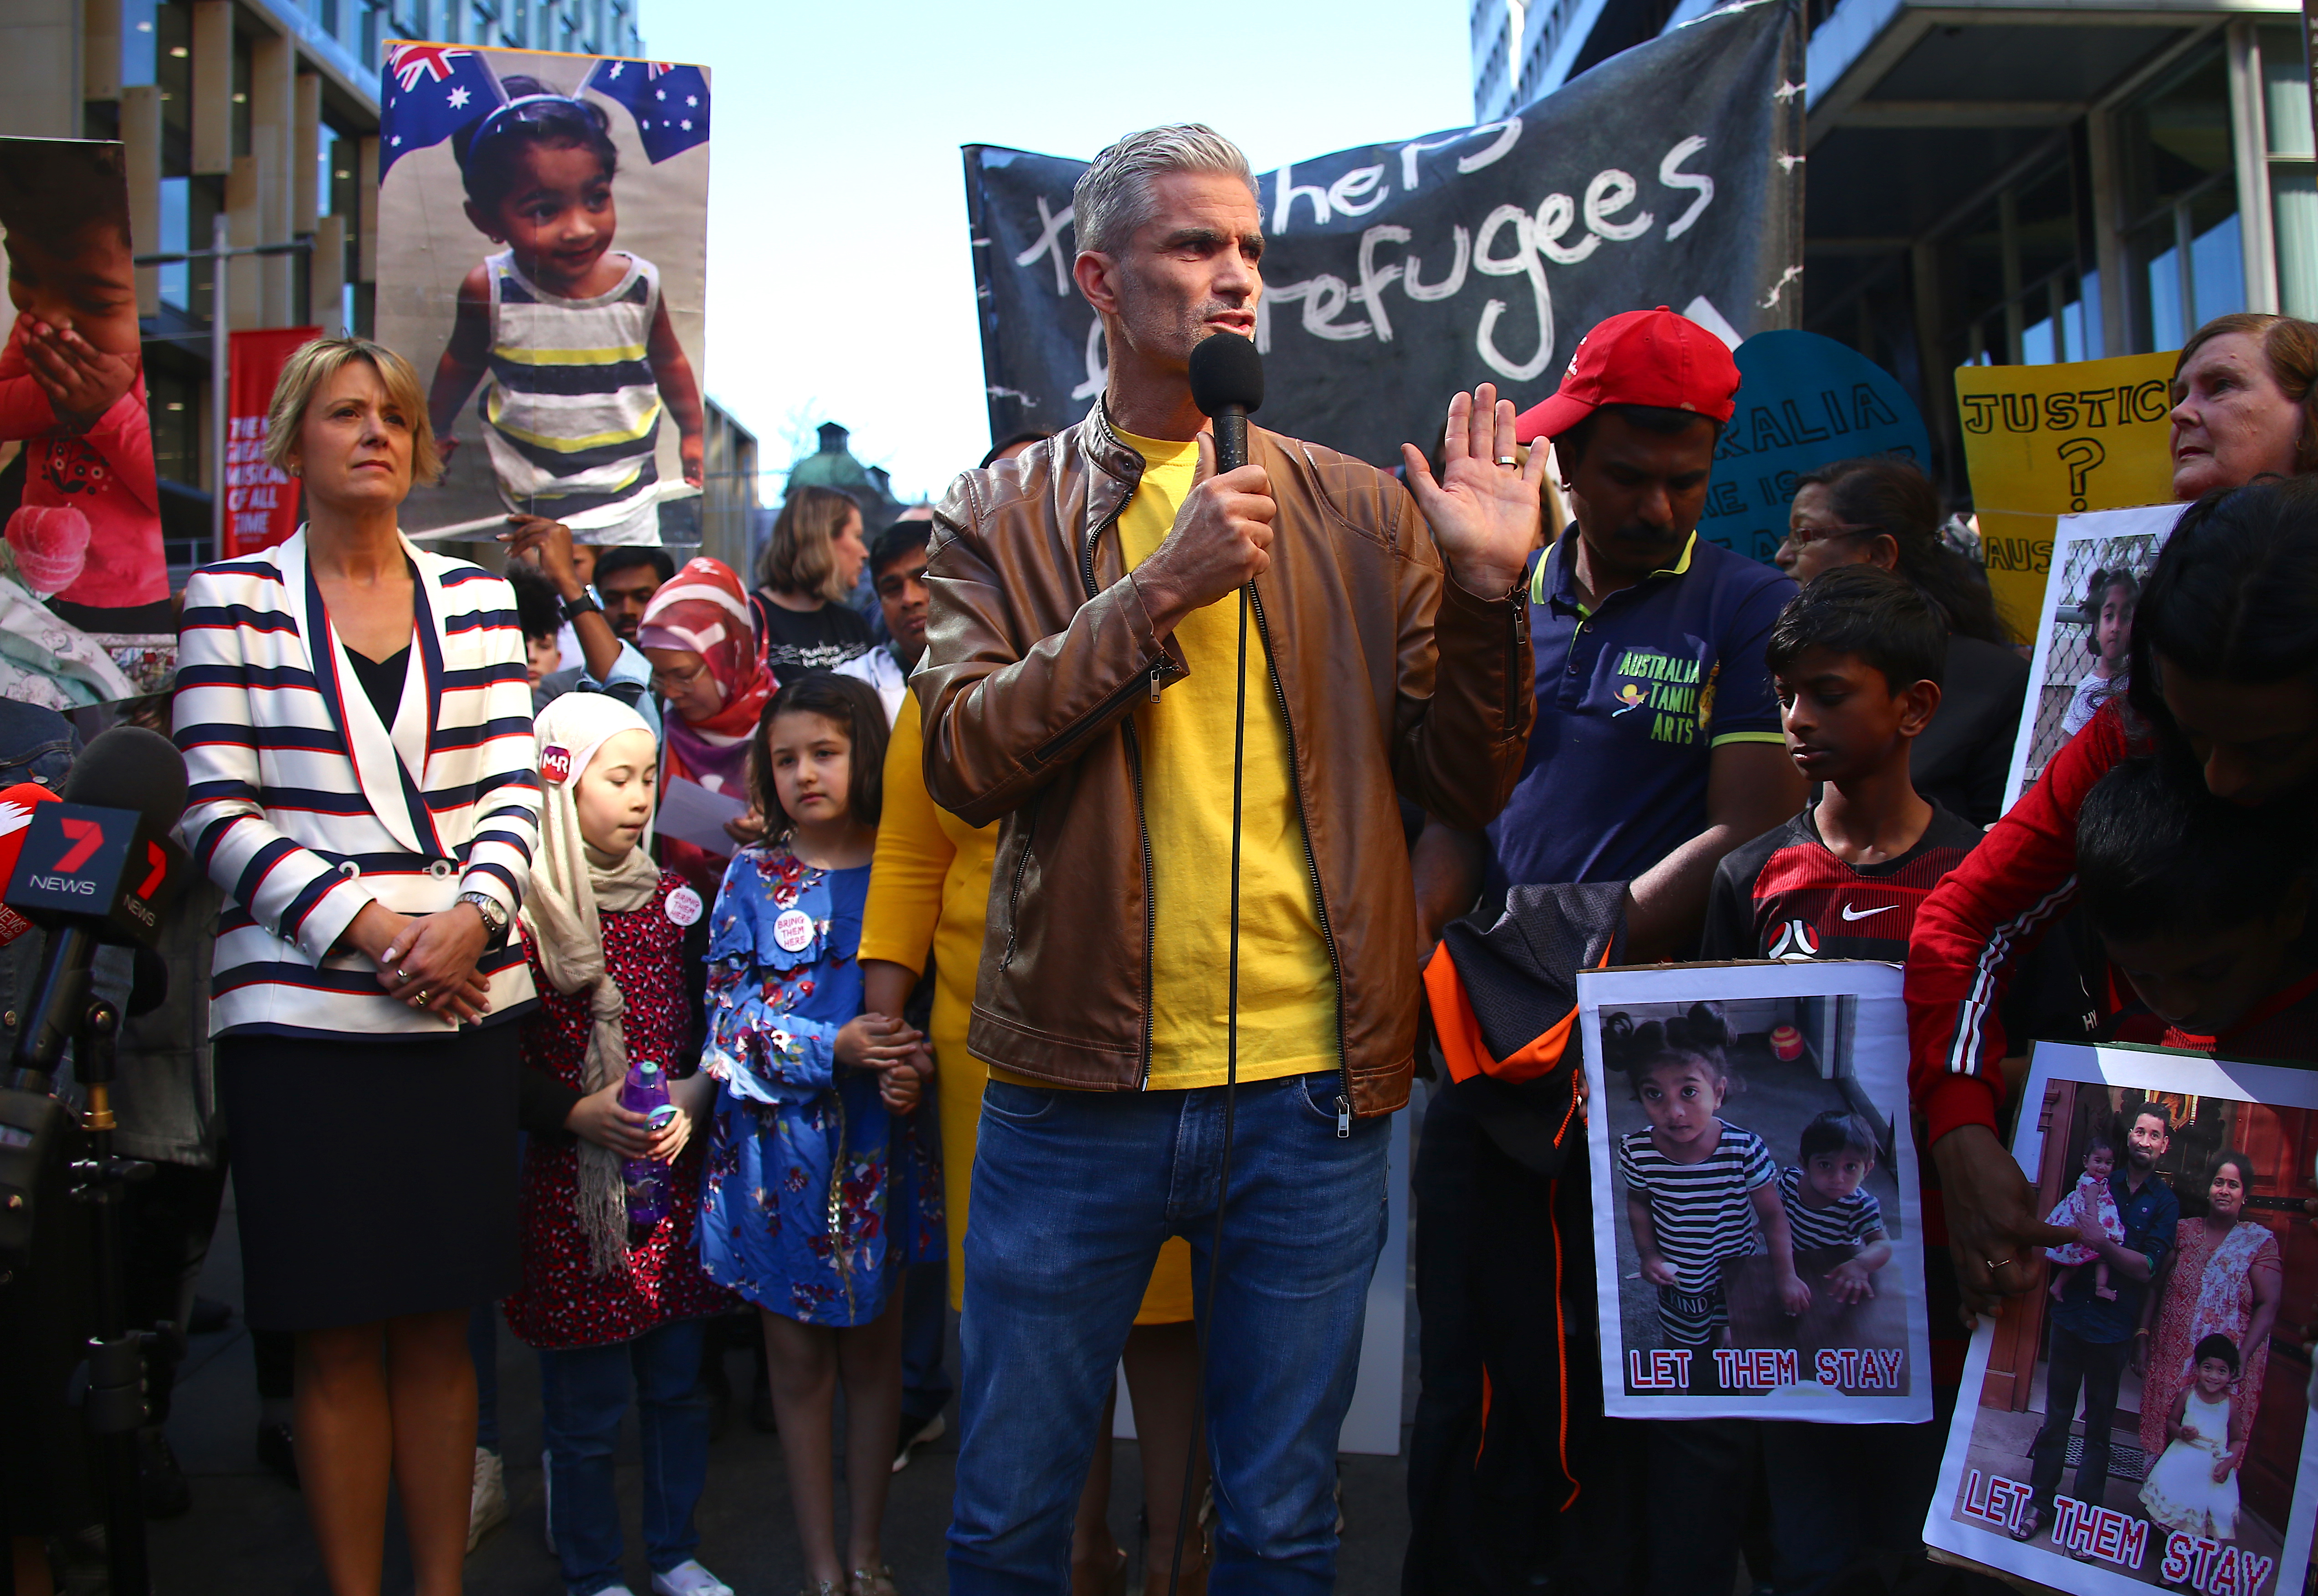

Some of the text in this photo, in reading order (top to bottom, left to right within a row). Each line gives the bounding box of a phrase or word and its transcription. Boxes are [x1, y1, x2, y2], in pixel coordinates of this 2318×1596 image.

[1256, 134, 1714, 381] refugees
[1714, 382, 1899, 460] RALIA
[1964, 379, 2174, 434] JUSTIC
[2058, 437, 2106, 513] ?
[1985, 536, 2054, 575] AUS
[1617, 651, 1700, 684] AUSTRALIA
[1649, 681, 1696, 714] TAMIL
[1650, 712, 1694, 749] ARTS
[29, 874, 97, 895] NEWS
[674, 893, 700, 908] BRING
[123, 894, 157, 927] NEWS
[670, 911, 692, 924] HERE
[674, 901, 695, 914] THEM
[777, 916, 805, 929] BRING
[781, 926, 804, 939] THEM
[784, 935, 806, 947] HERE
[2082, 1009, 2098, 1031] HY
[1630, 1348, 1903, 1389] LET THEM STAY
[1961, 1468, 2273, 1596] LET THEM STAY
